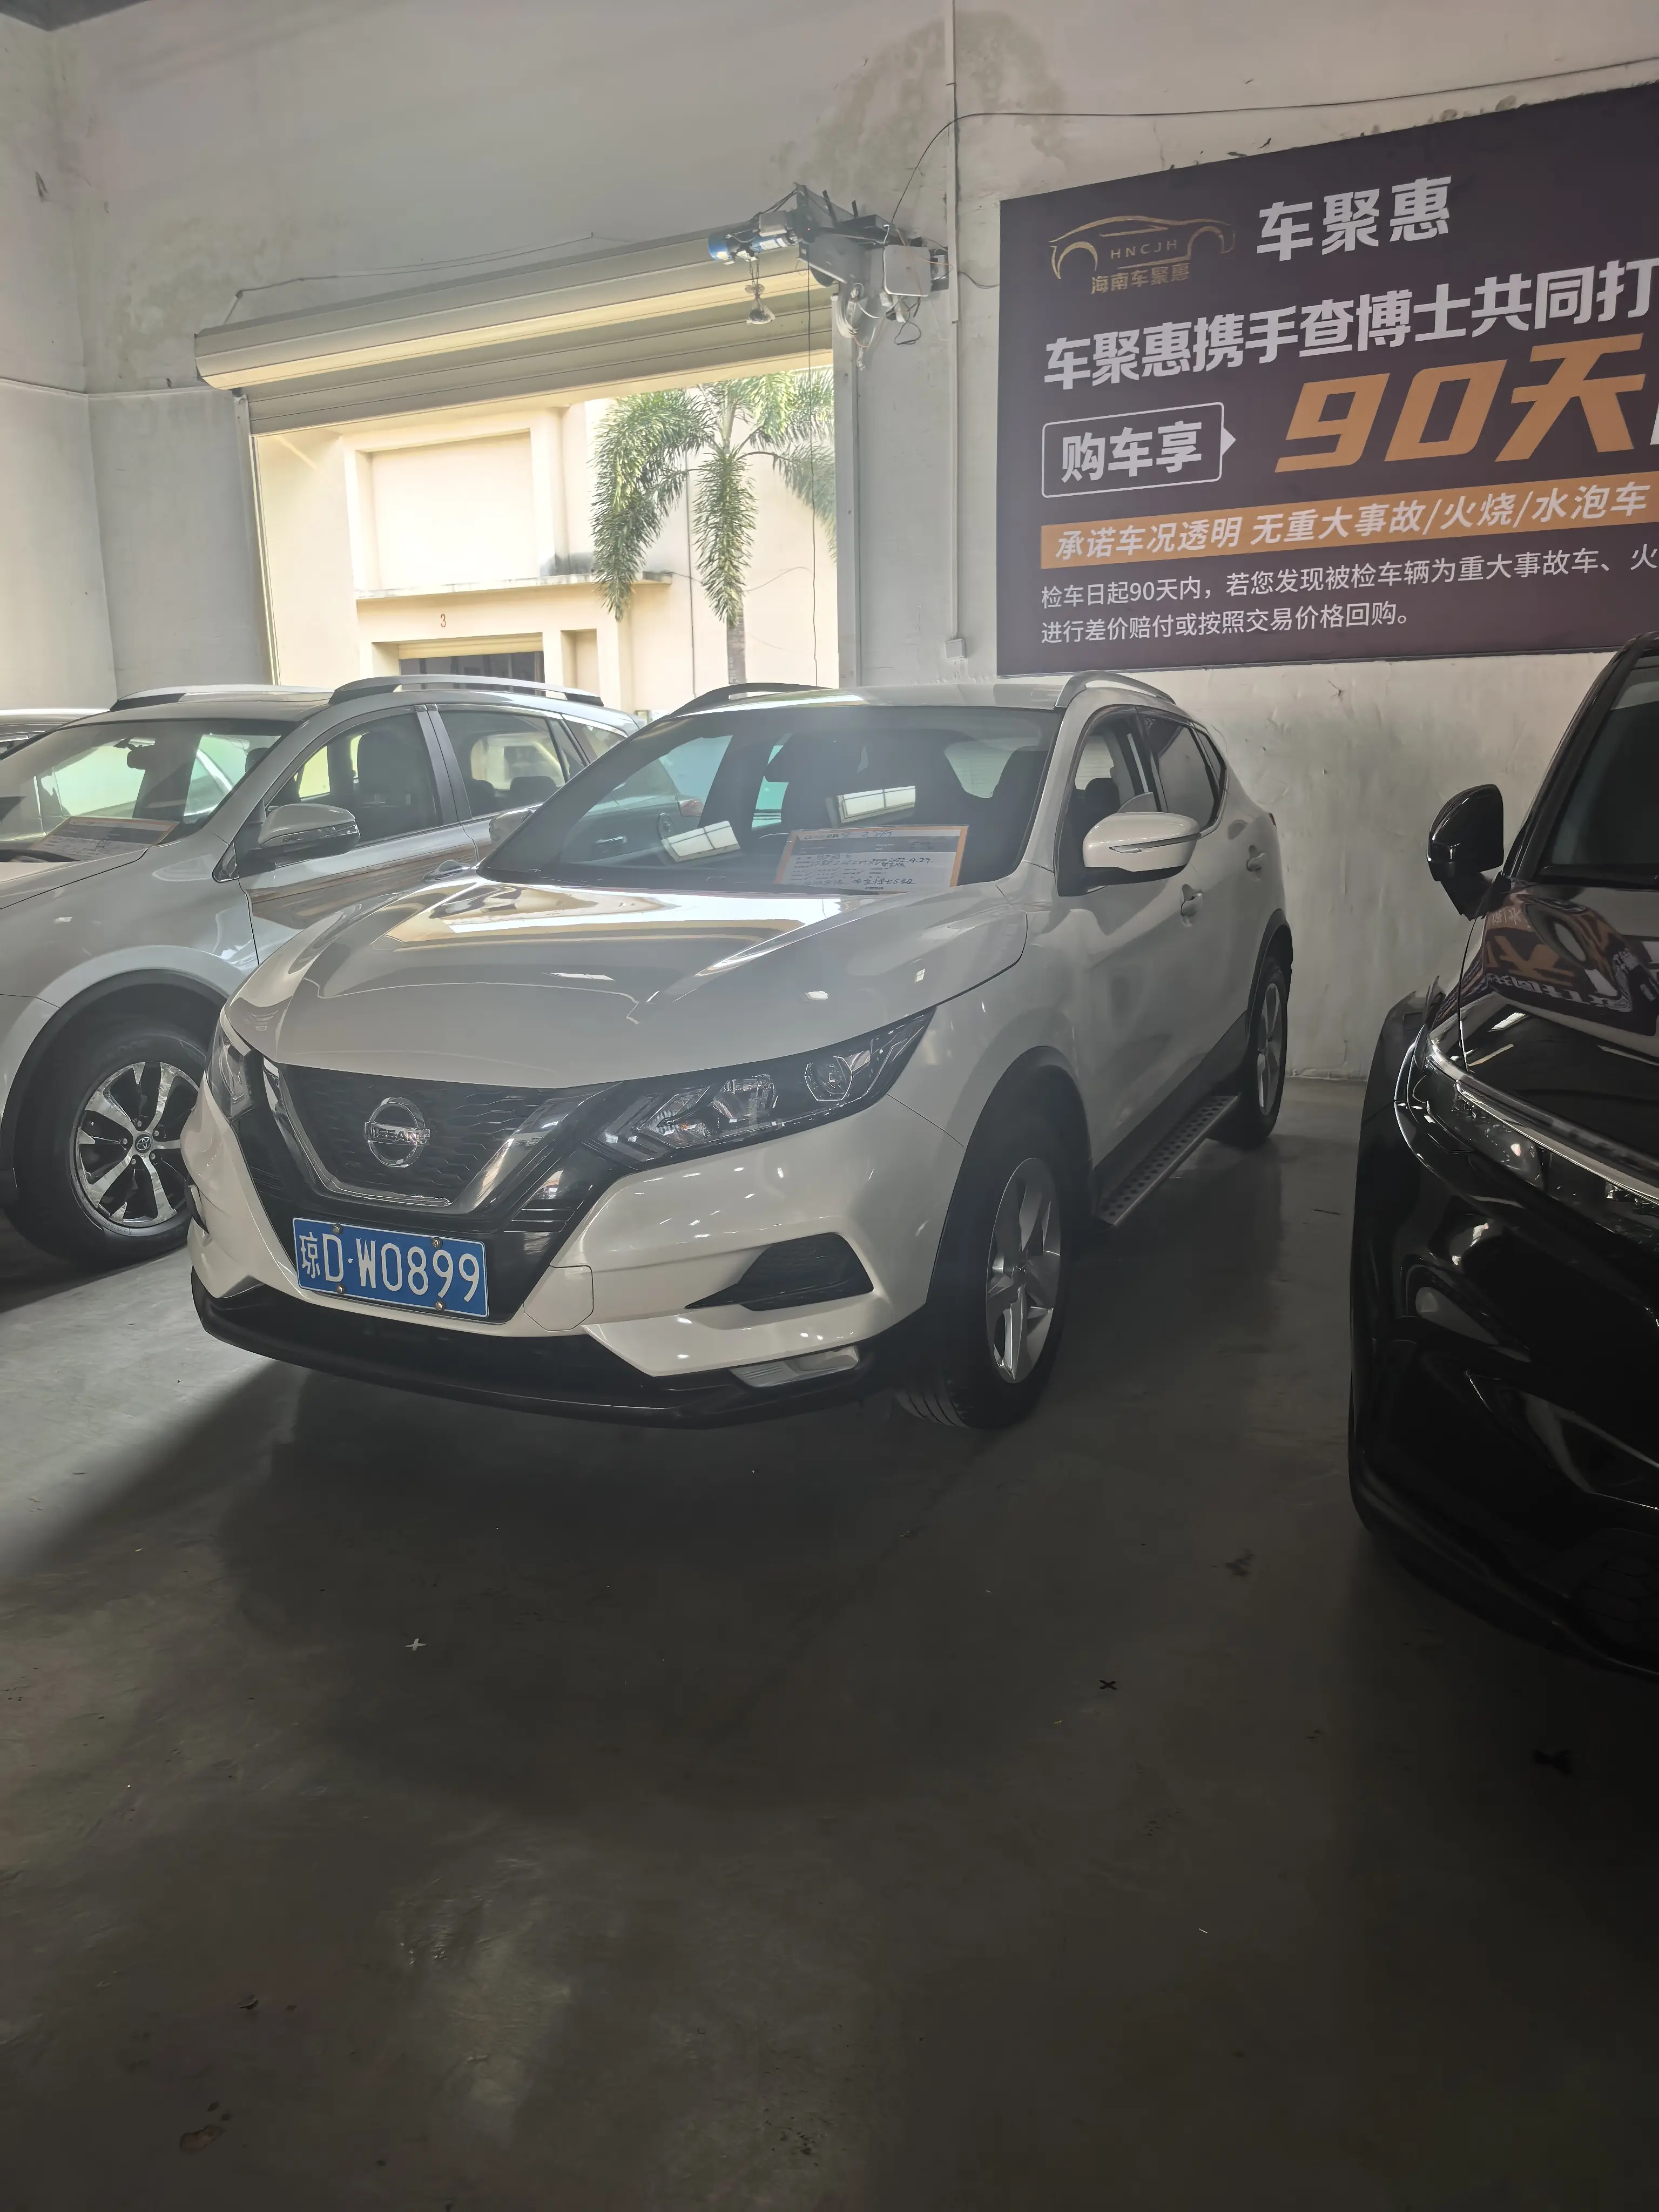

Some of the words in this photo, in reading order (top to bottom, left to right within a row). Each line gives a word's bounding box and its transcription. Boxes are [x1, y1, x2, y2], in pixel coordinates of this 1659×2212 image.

[1257, 176, 1451, 261] 车聚惠
[1110, 239, 1178, 260] HNCJH
[1091, 263, 1190, 294] 海南车聚惠
[1044, 257, 1659, 390] 车聚惠携手查博士共同打
[1061, 420, 1202, 483] 购车享
[1055, 516, 1243, 561] 承诺车况透明
[441, 613, 446, 628] 3
[1041, 601, 1407, 644] 进行差价赔付或按照交易价格回购。
